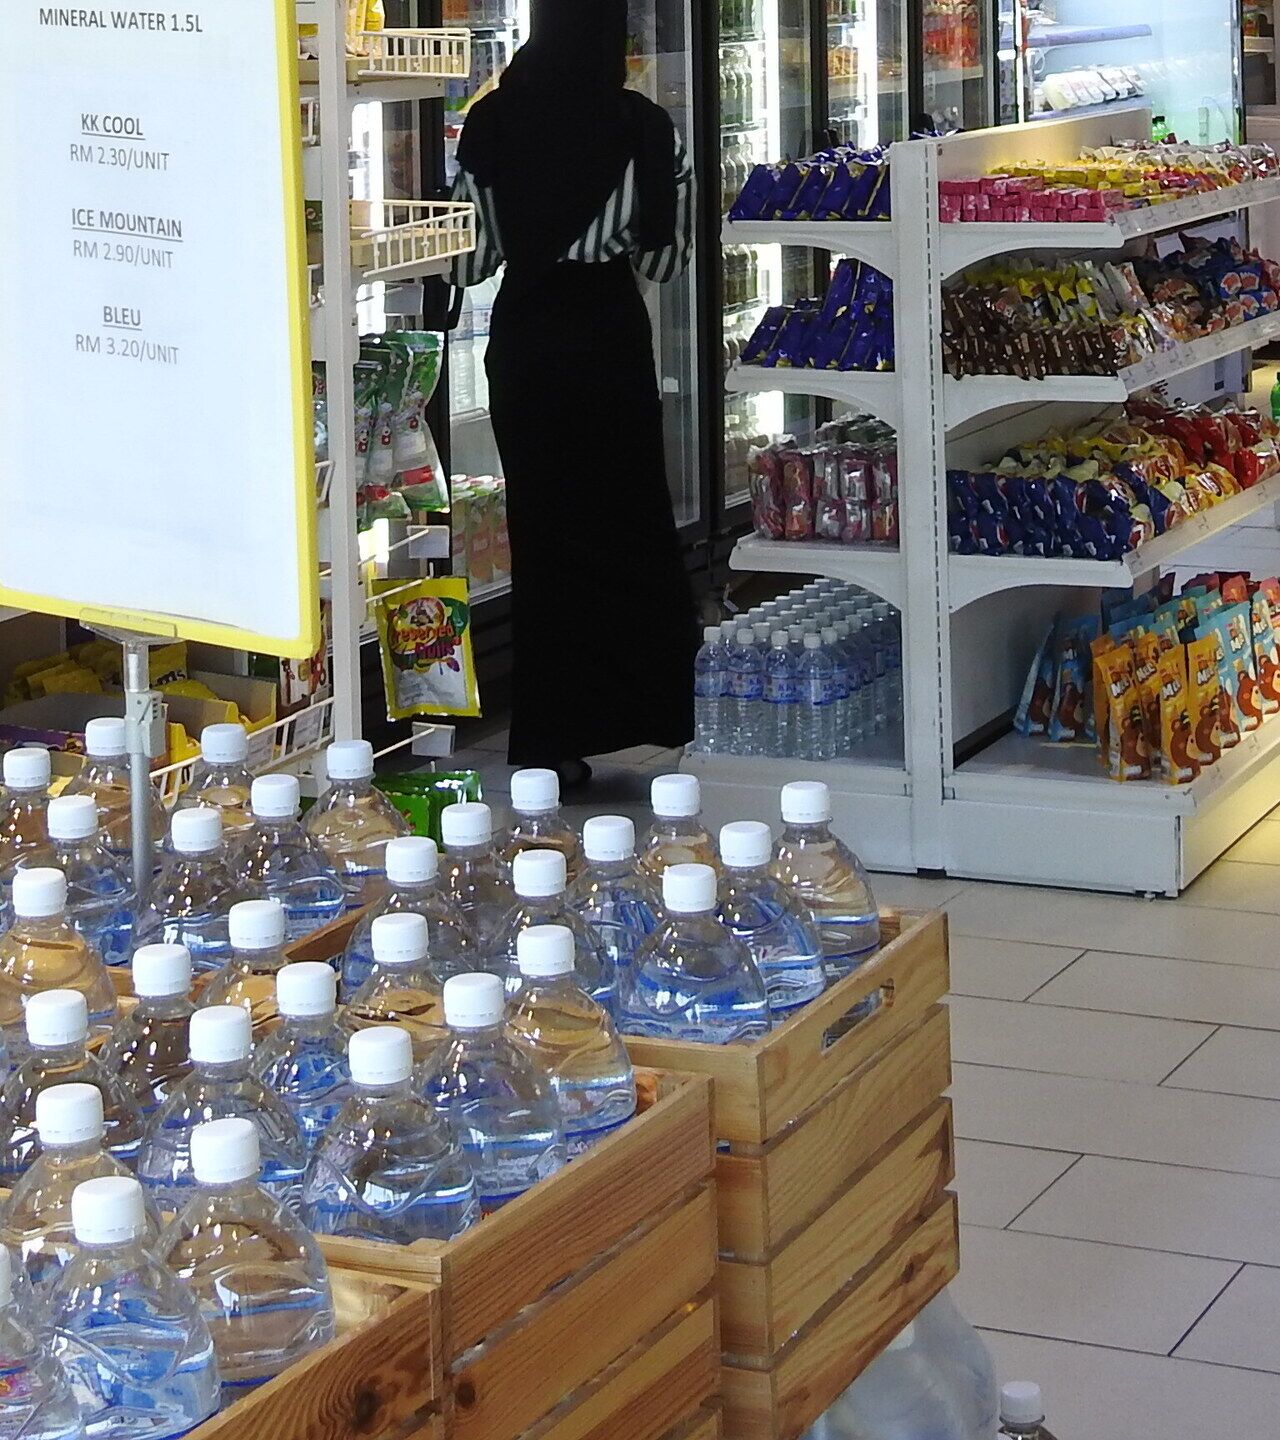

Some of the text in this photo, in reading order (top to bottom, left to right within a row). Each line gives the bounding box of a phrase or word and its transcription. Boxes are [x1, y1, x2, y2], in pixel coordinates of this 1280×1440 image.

[38, 7, 203, 34] MINERAL WATER 1.5L
[80, 113, 145, 137] KK COOL
[69, 143, 171, 172] RM 2.30/UNIT
[71, 207, 183, 239] ICE MOUNTAIN
[72, 239, 174, 270] RM 2.90/UNIT
[102, 305, 142, 327] BLEU
[74, 333, 180, 366] RM 3.20/UNIT
